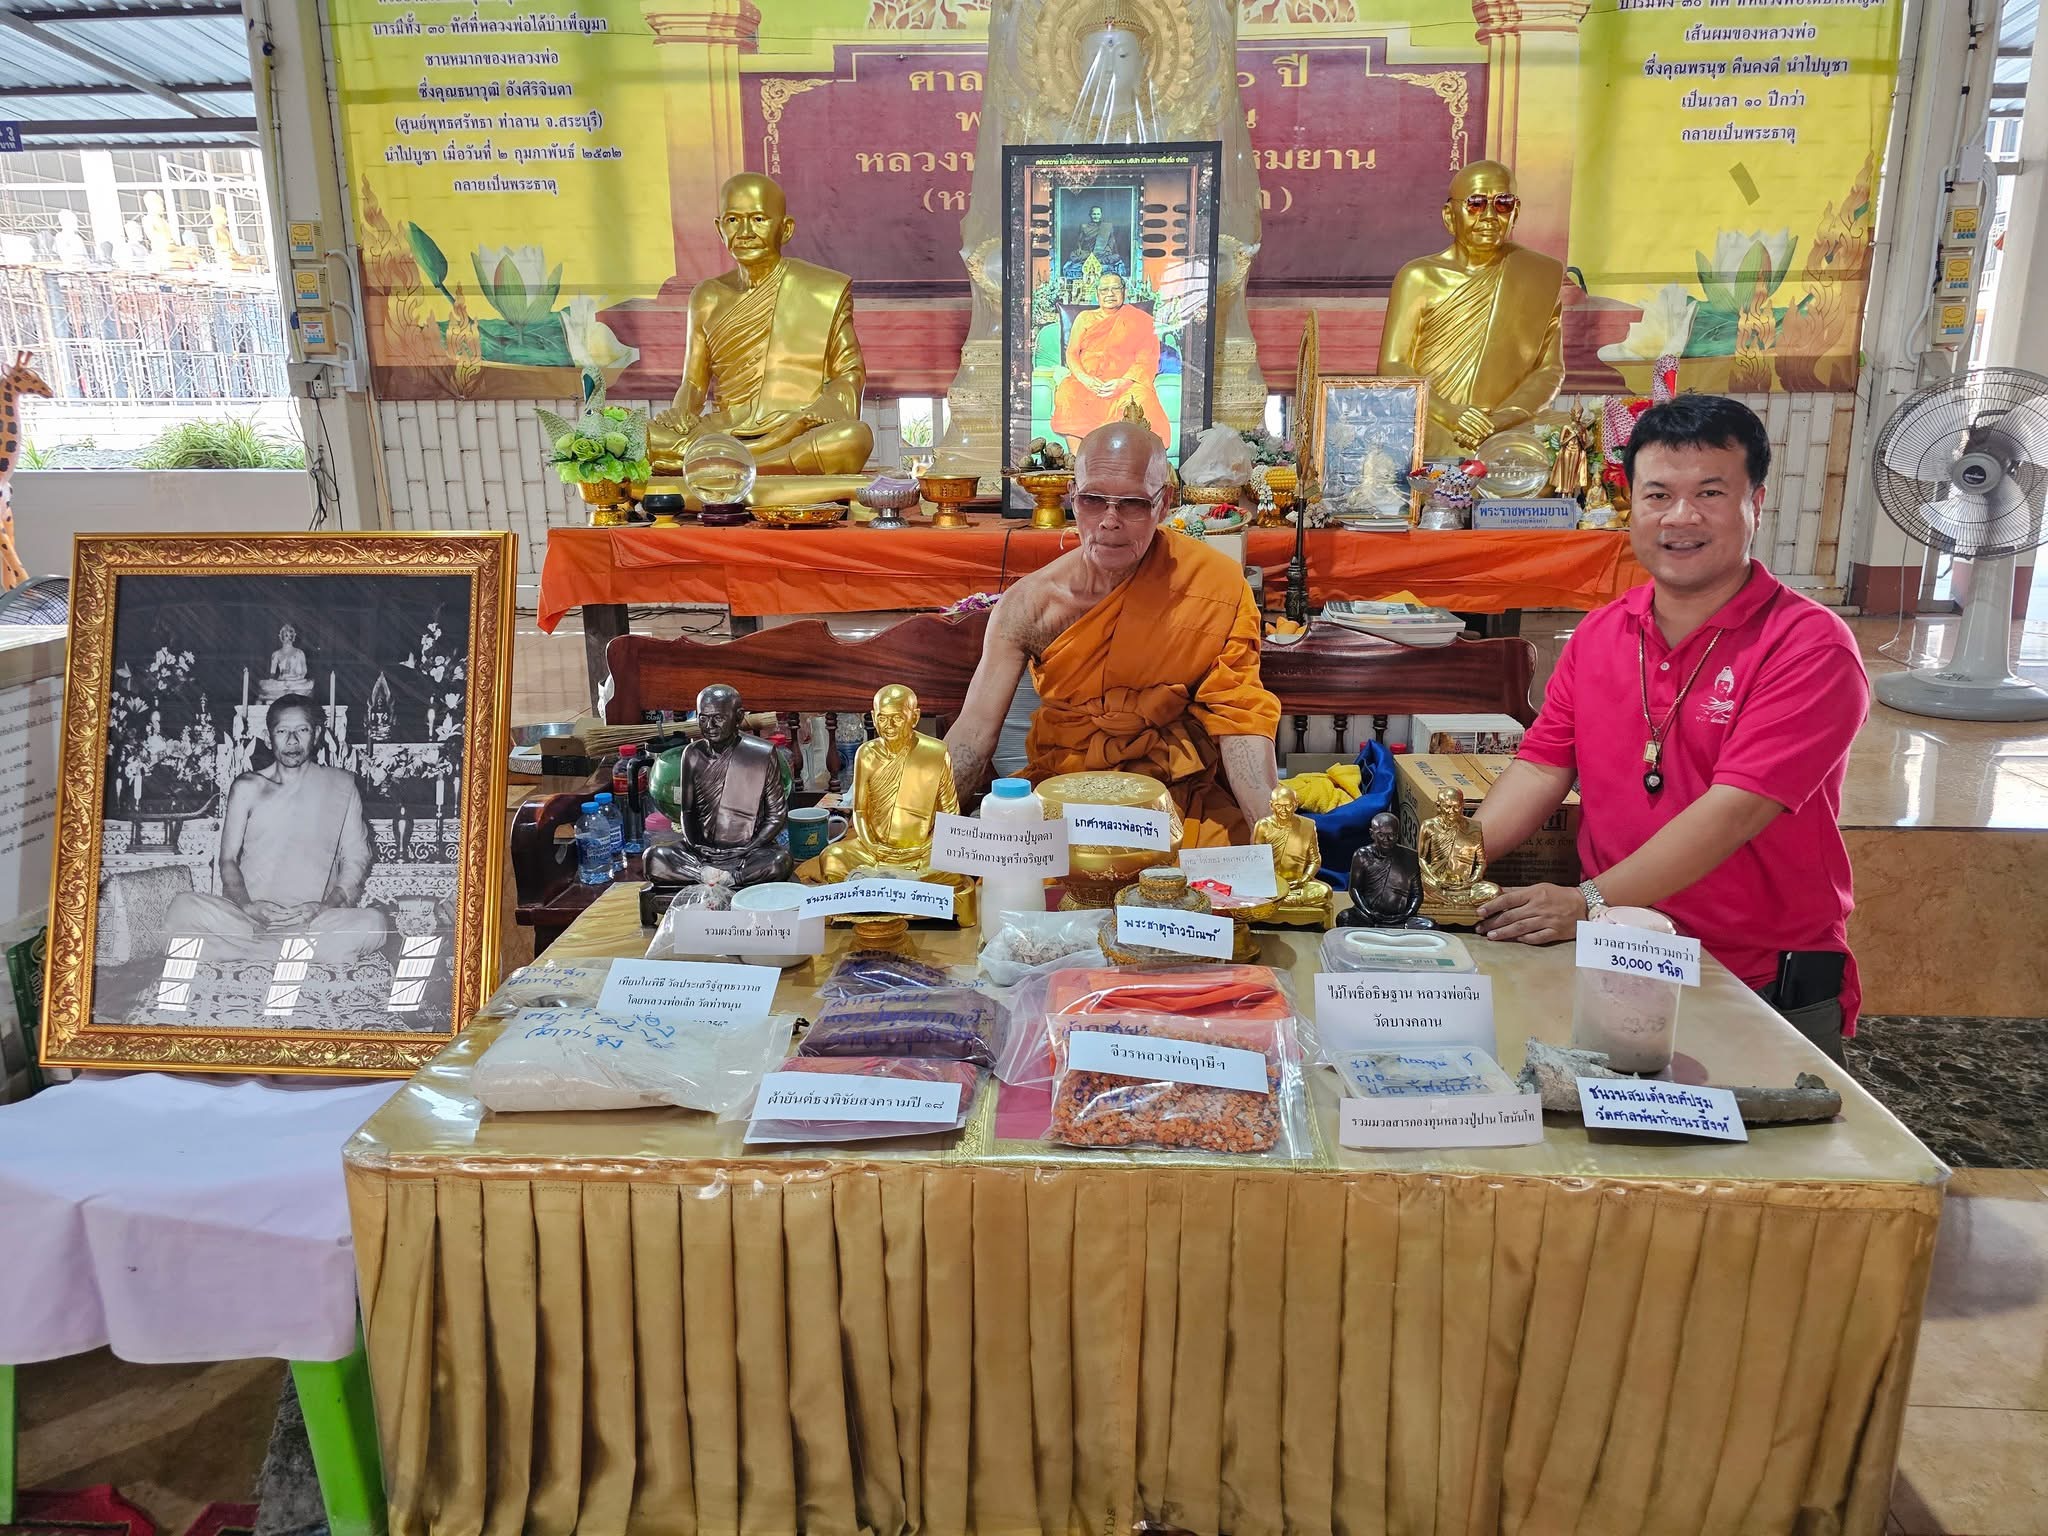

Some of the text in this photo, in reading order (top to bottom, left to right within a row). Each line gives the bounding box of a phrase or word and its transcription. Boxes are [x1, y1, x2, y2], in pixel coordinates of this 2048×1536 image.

[374, 12, 607, 35] บารมีทั้ง ๓๐ ทัศที่หลวงพ่อได้บำเพ็ญมา
[1685, 21, 1816, 42] เส้นผมของหลวงพ่อ
[426, 48, 559, 66] ชานหมากของหลวงพ่อ
[1644, 54, 1726, 81] ซึ่งคุณพรนุช
[1787, 54, 1848, 77] นำไปบูชา
[1272, 53, 1309, 87] ปี
[506, 79, 573, 97] อังศิริจินดา
[1681, 89, 1805, 108] เป็นเวลา ๑๐ ปีกว่า
[395, 110, 604, 134] (ศูนย์พุทธศรัทธา ท่าลาน จ.สระบุรี)
[1681, 122, 1796, 144] กลายเป็นพระธาตุ
[385, 144, 437, 165] นำไปบูชา
[442, 139, 492, 160] เมื่อวันที่
[515, 143, 575, 165] กุมภาพันธ์
[454, 173, 558, 195] กลายเป็นพระธาตุ
[1480, 506, 1569, 517] พระราชพรหมยาน
[704, 924, 791, 940] รวมผงวิเศษ วัดท่าซุง
[1593, 937, 1694, 962] มวลสารเก่ารวมกว่า
[1611, 954, 1684, 980] 30,000 ชนิด
[618, 976, 666, 987] เทียนในพิธี
[1327, 979, 1480, 1003] ไม้โพธิ์อธิษฐาน หลวงพ่อเงิน
[627, 994, 695, 1008] โดยหลวงพ่อเล็ก
[1373, 1013, 1443, 1028] วัดบางคลาน
[767, 1090, 945, 1109] ผ้ายันต์ธงพิชัยสงครามปี ๑๘
[1352, 1109, 1535, 1130] รวมมวลสารกองทุนหลวงปู่ปาน โสนันโท
